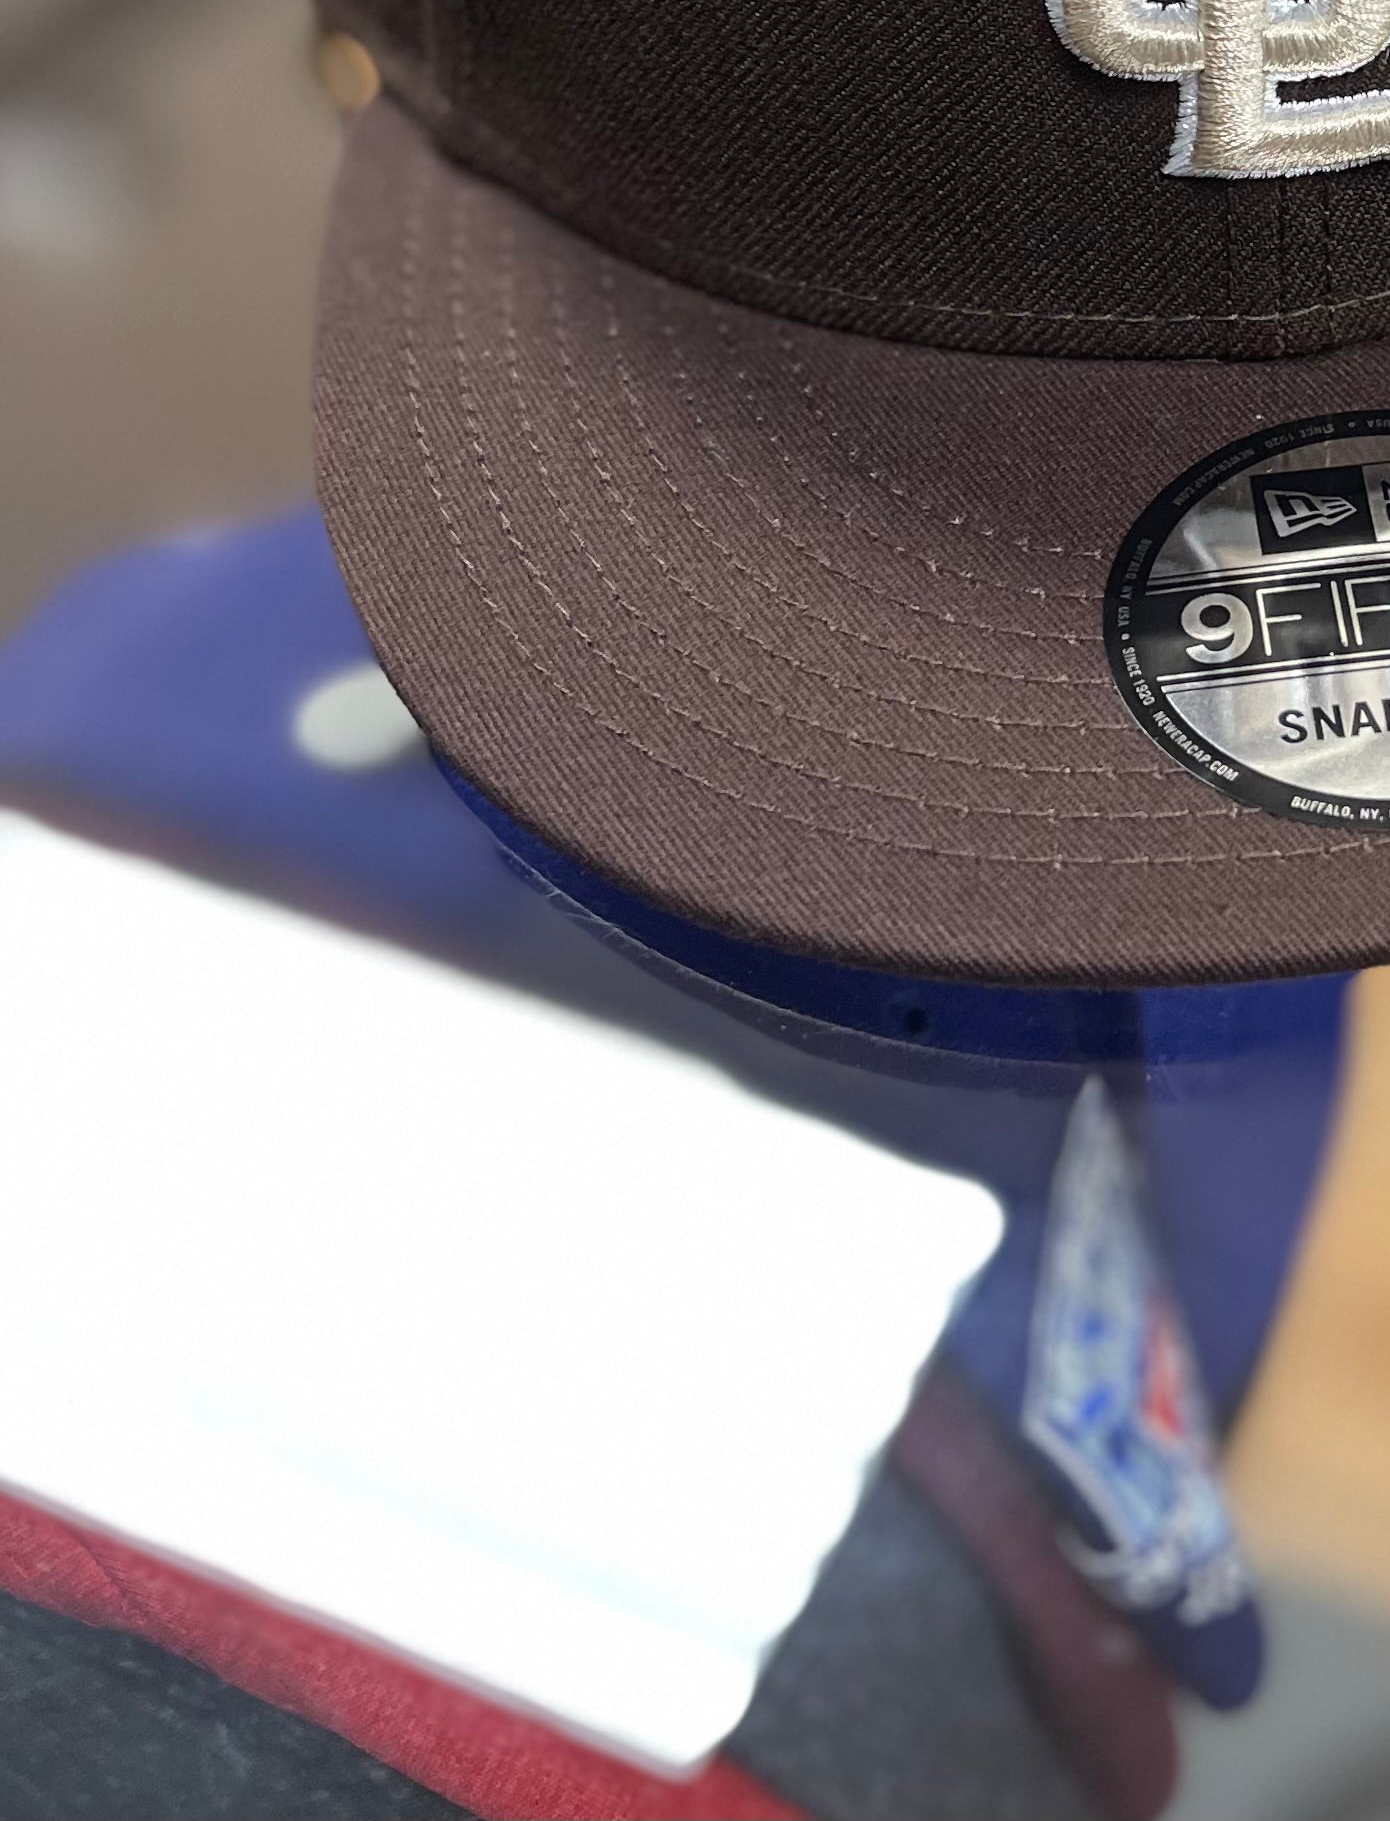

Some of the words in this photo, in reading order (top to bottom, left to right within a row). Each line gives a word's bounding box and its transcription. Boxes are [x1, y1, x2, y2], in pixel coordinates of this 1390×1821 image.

[1118, 606, 1131, 627] USA
[1122, 646, 1143, 678] SINCE
[1133, 679, 1156, 706] 1920
[1153, 710, 1240, 781] NEWERACAP.COM
[1290, 795, 1355, 820] BUFFALO,
[1360, 808, 1384, 821] NY,
